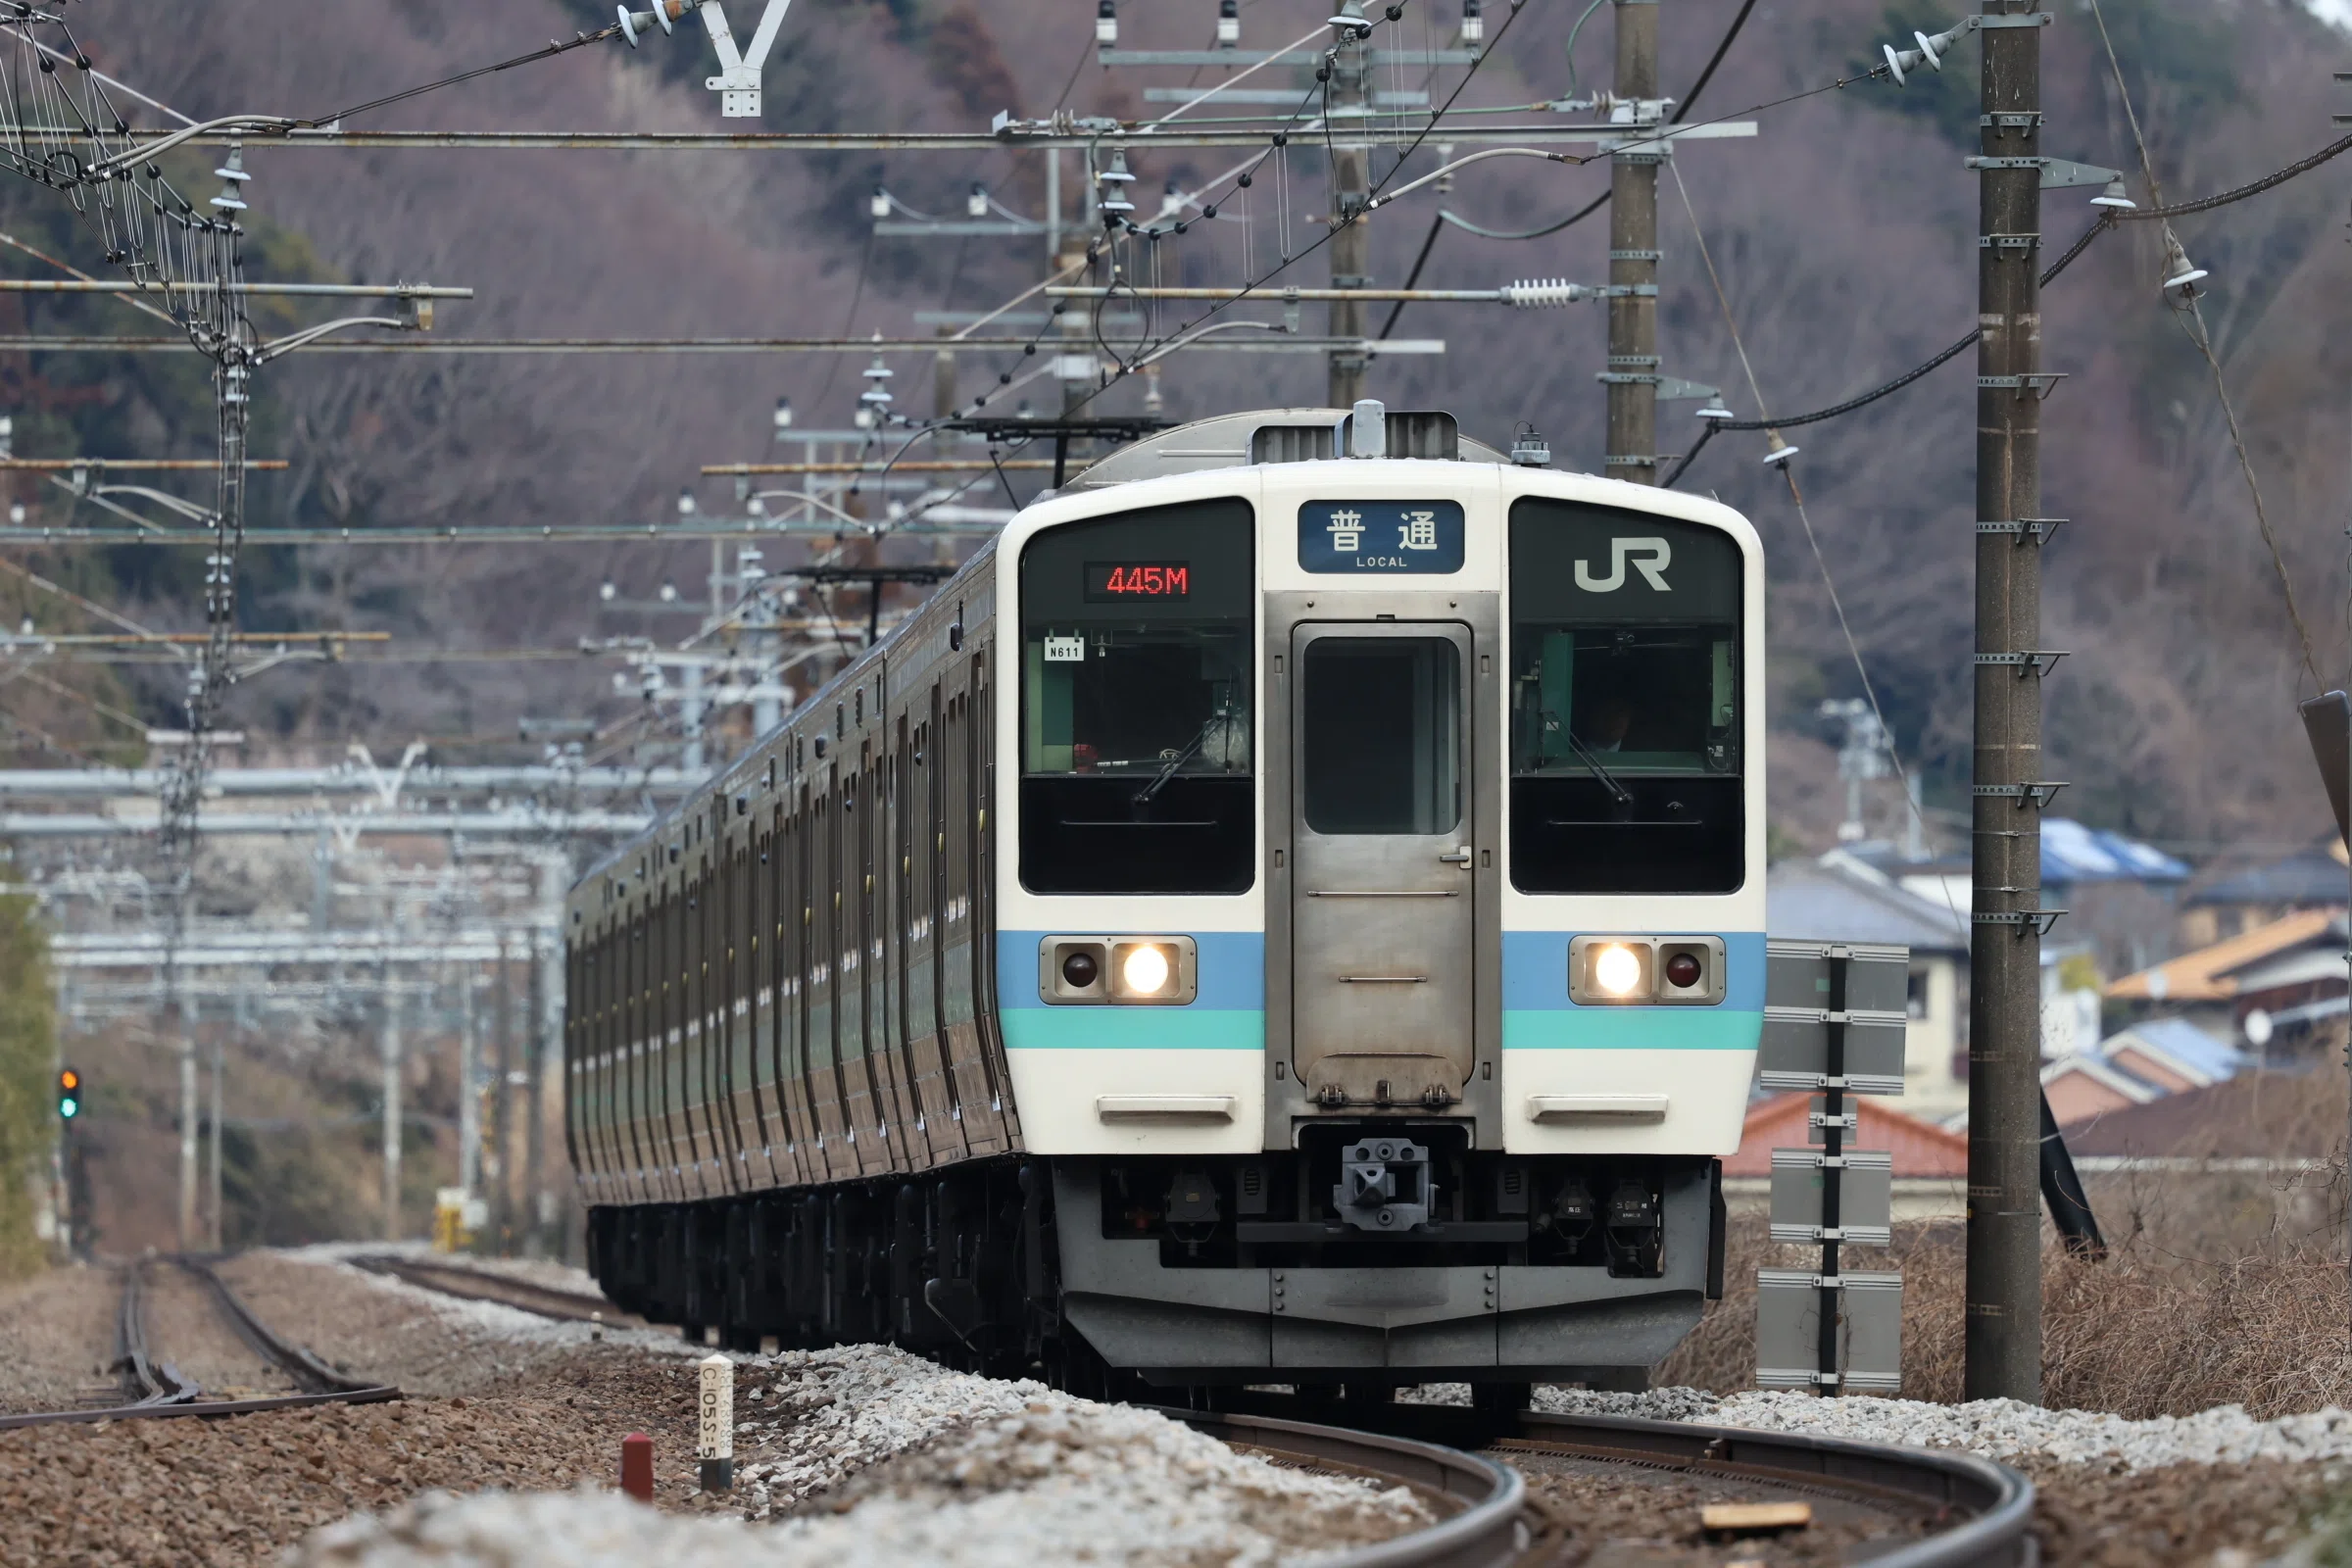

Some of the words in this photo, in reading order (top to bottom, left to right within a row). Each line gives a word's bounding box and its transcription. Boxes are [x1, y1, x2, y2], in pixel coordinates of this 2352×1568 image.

[1326, 509, 1438, 552] 普通
[1356, 557, 1407, 567] LOCAL
[1574, 536, 1672, 593] JR
[1106, 566, 1189, 594] 445M
[1050, 647, 1079, 658] N611
